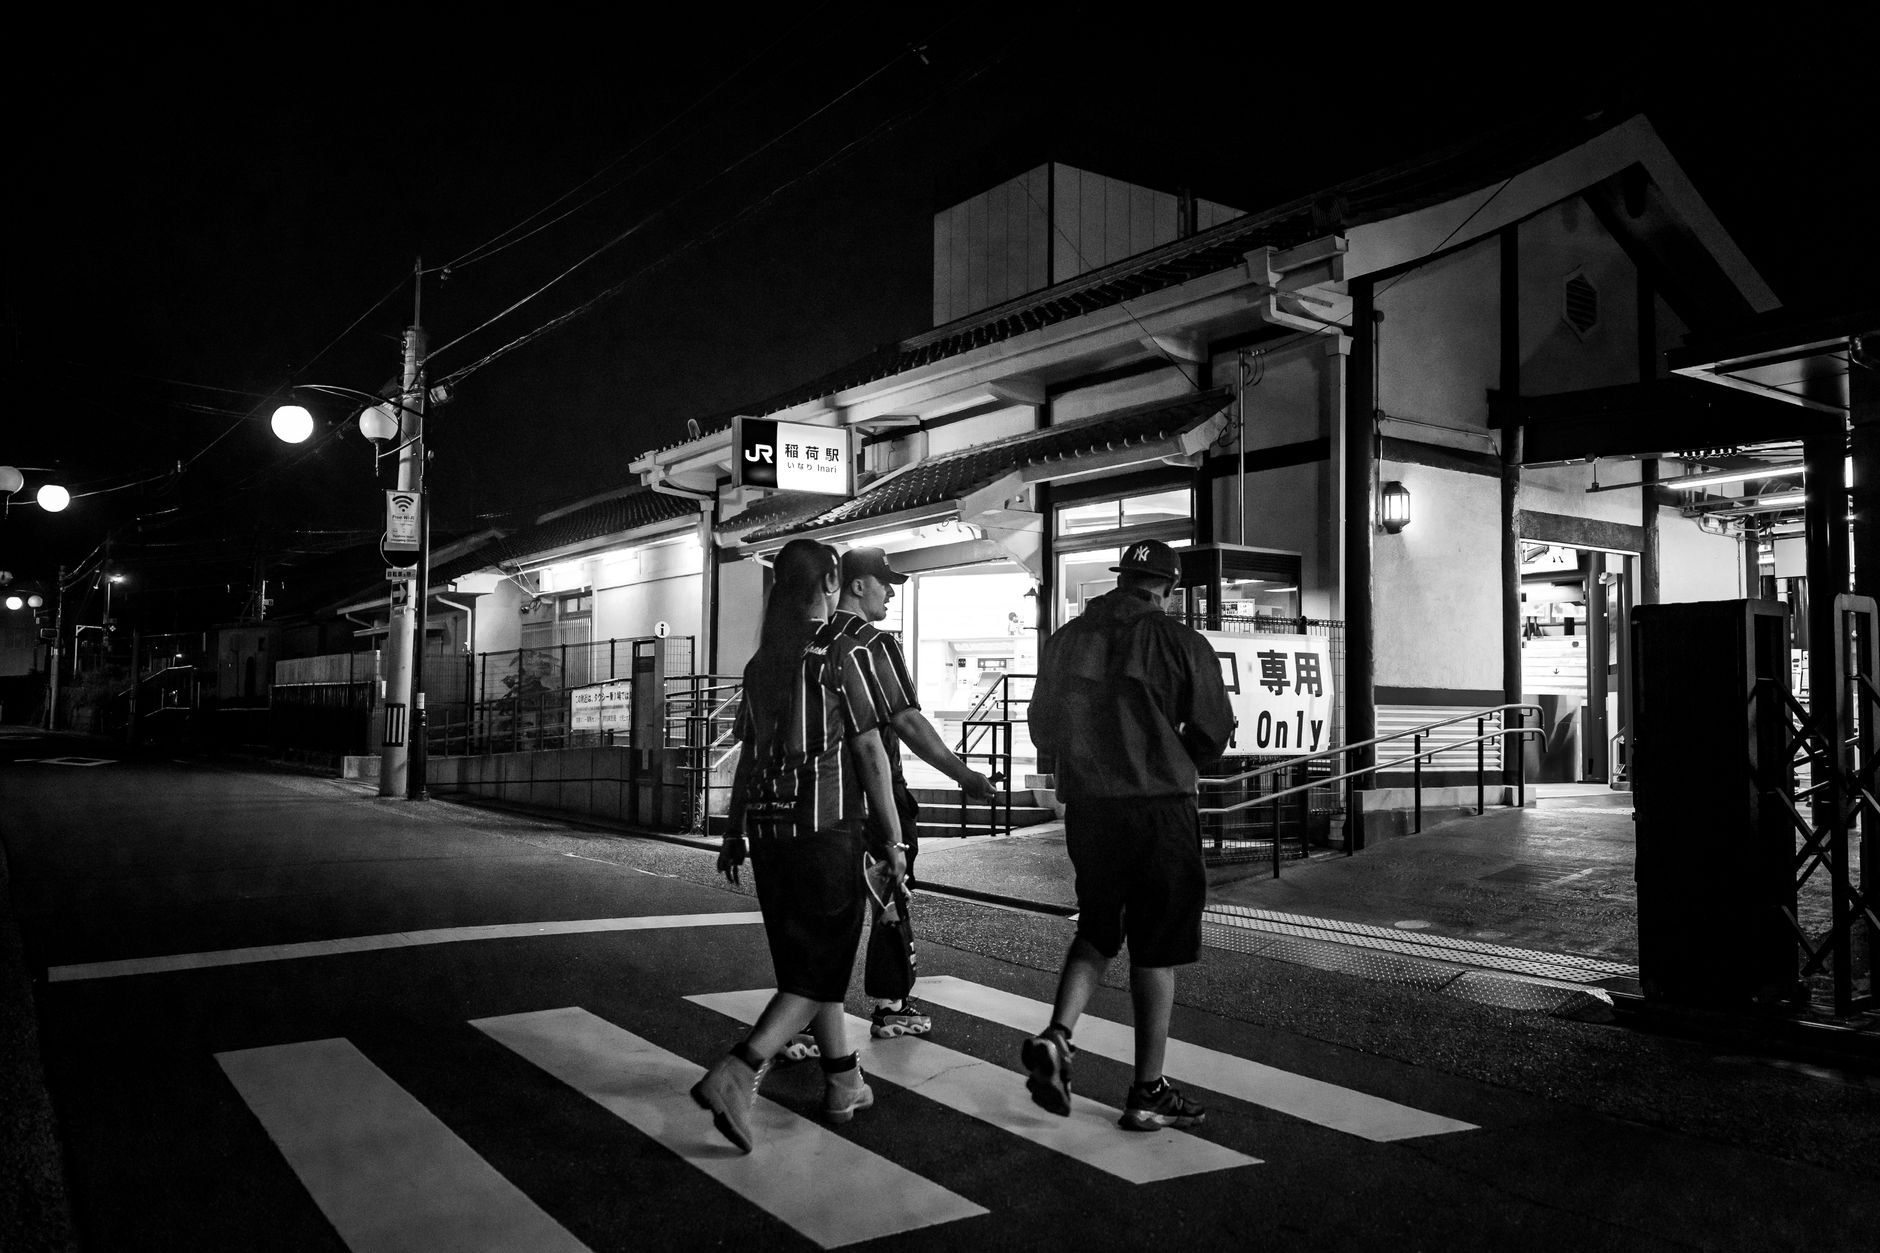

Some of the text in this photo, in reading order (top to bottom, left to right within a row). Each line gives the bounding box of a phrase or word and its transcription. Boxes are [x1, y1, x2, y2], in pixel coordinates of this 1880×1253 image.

[745, 443, 774, 464] JR
[784, 443, 840, 462] 稲荷駅
[787, 461, 837, 474] いなり Inari
[1133, 545, 1150, 562] NY
[1256, 710, 1324, 752] Only
